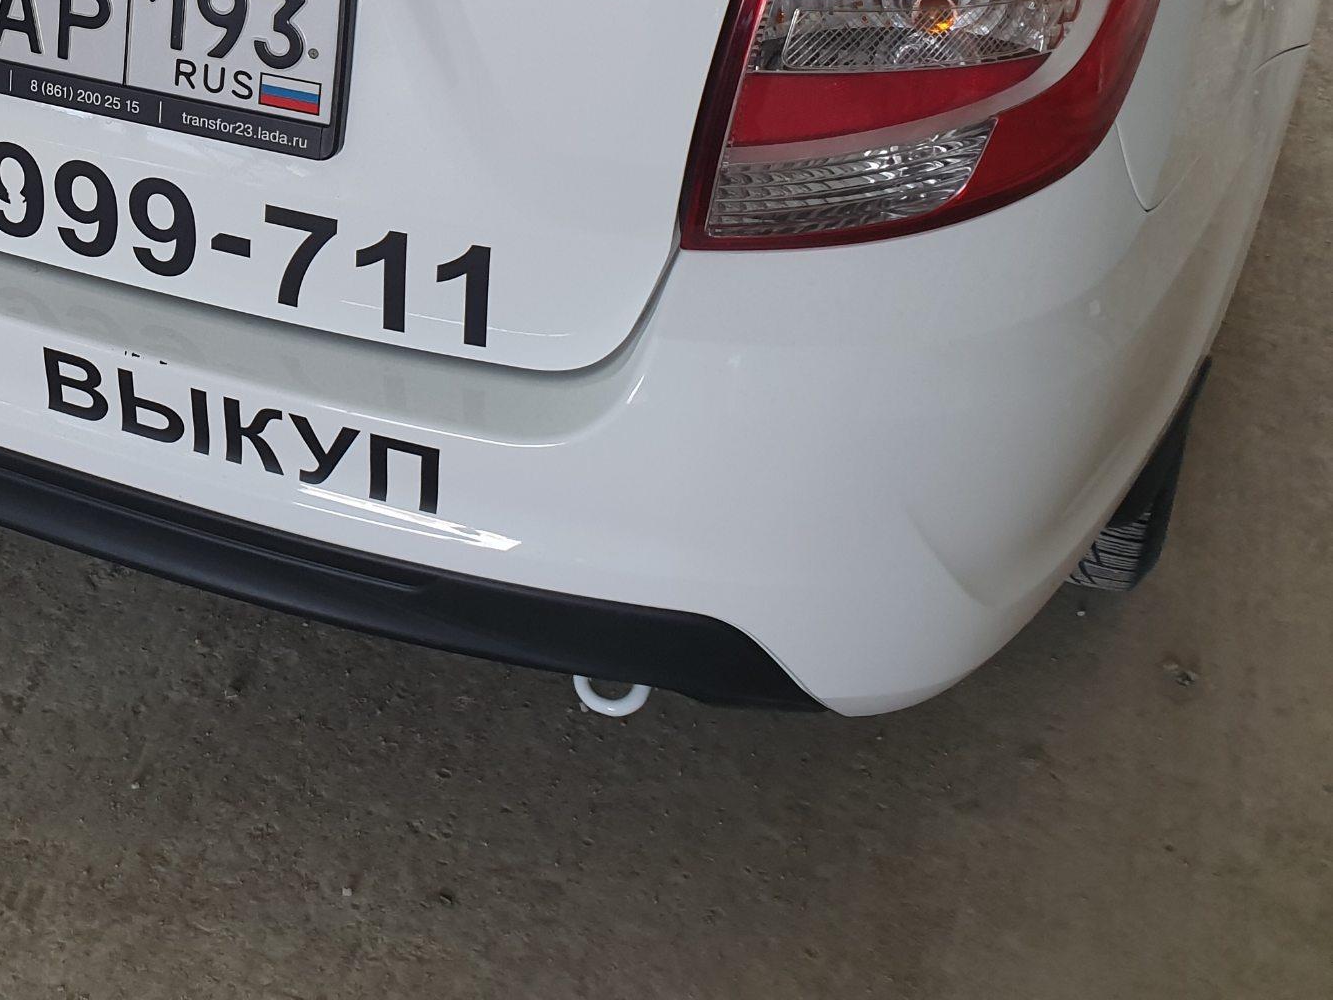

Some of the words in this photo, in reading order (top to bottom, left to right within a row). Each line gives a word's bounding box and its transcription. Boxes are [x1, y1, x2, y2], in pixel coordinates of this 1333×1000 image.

[30, 79, 38, 93] 8
[41, 80, 75, 102] (861)
[76, 88, 102, 106] 200
[104, 95, 121, 110] 25
[125, 99, 140, 114] 15
[181, 110, 308, 150] transfor23.lada.ru
[174, 57, 254, 101] RUS
[42, 346, 441, 515] ВЫКУП
